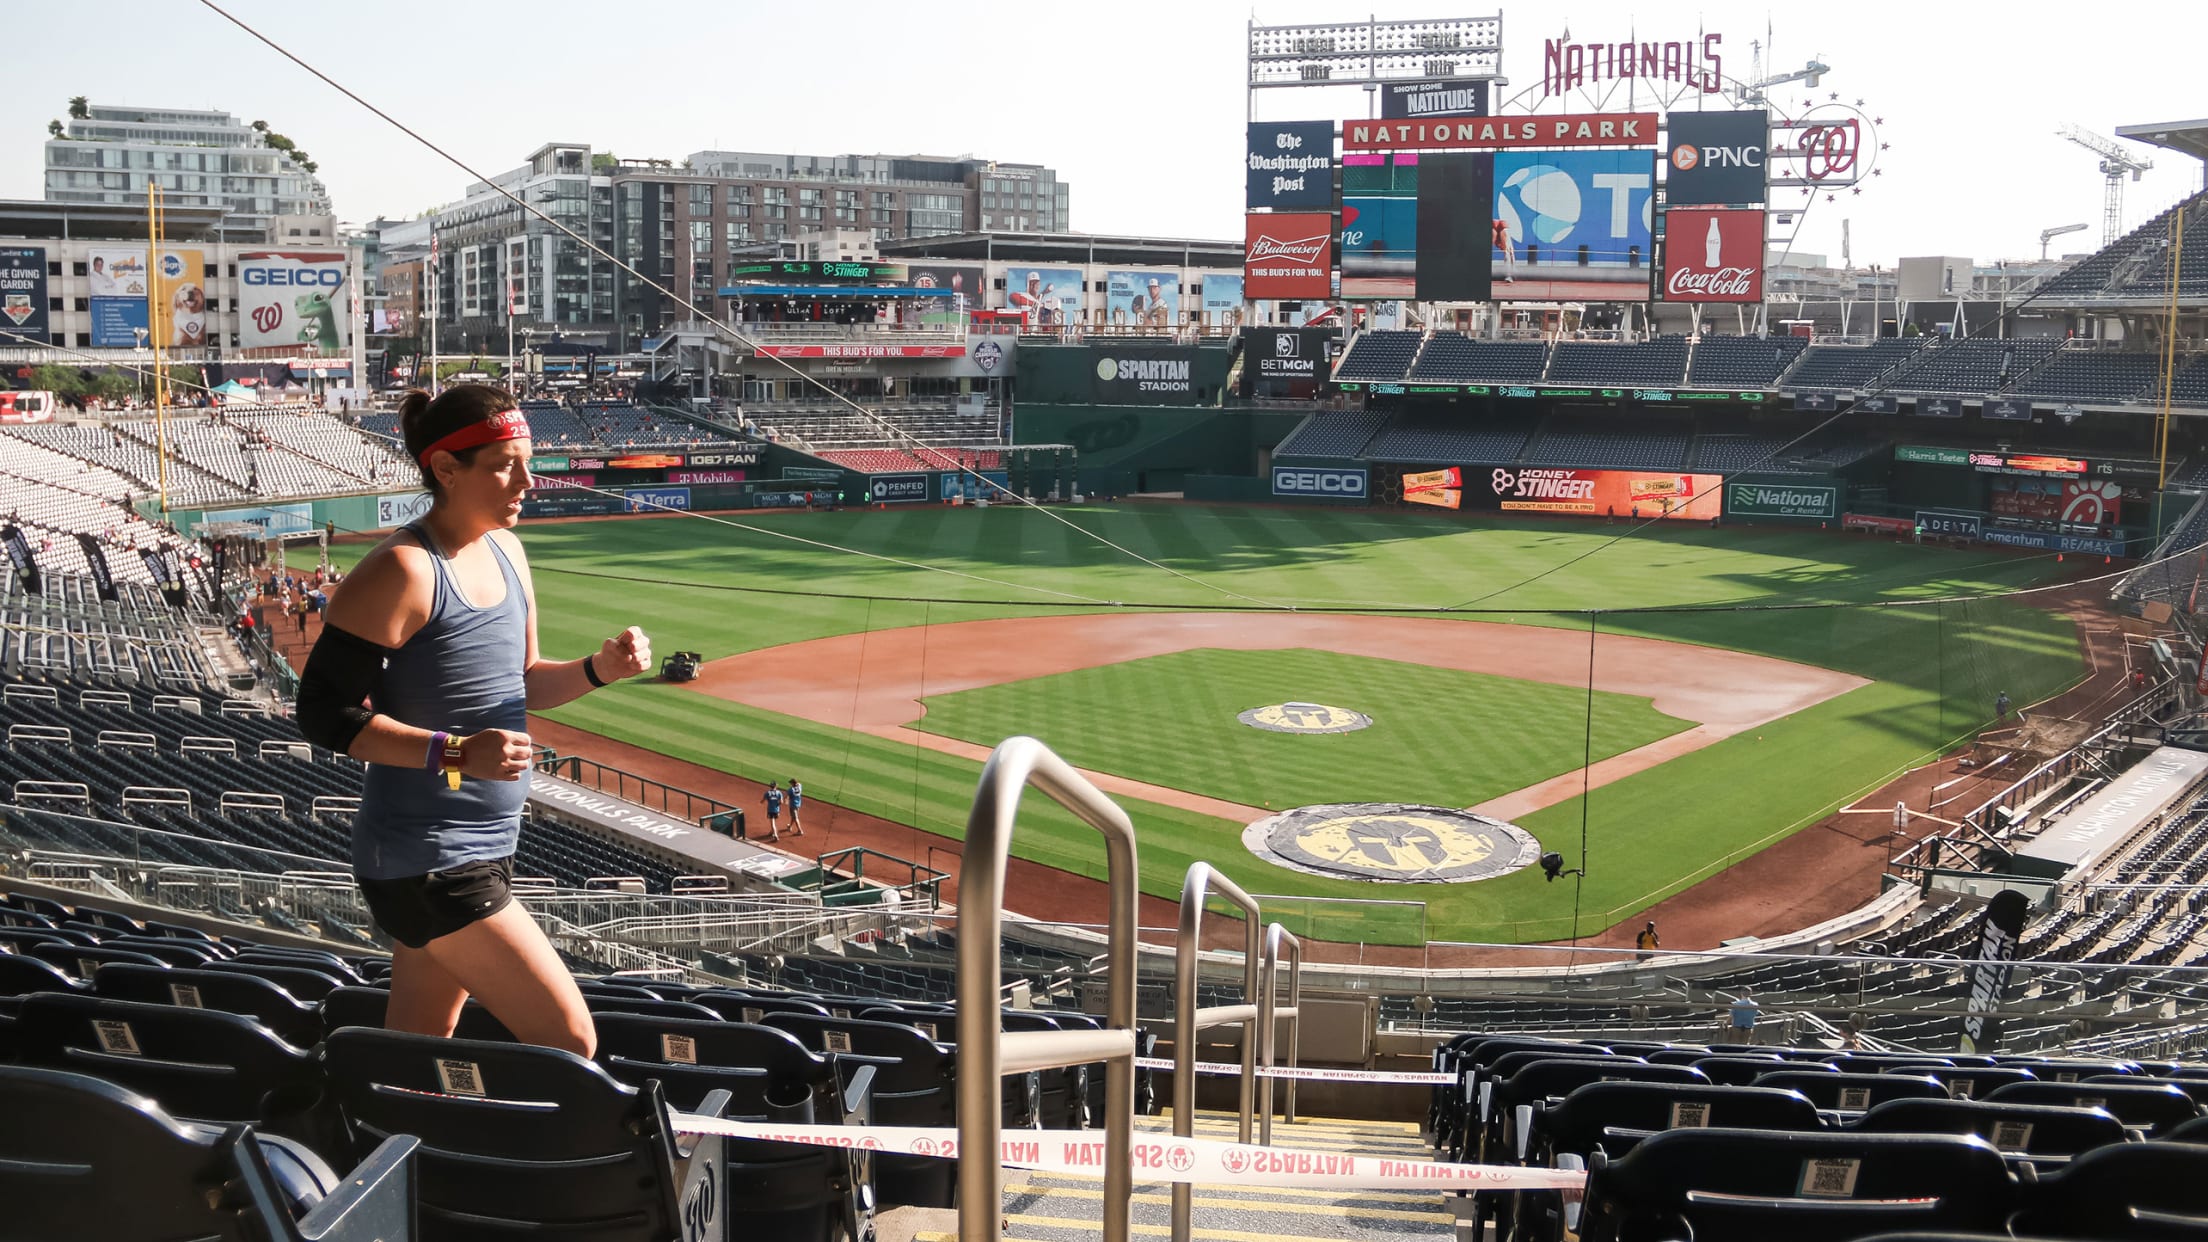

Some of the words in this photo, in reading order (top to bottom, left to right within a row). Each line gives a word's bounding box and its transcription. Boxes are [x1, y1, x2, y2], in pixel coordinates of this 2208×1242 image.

[1545, 33, 1721, 96] NATIONALS
[1393, 85, 1418, 94] SHOW
[1420, 83, 1443, 92] SOME
[1407, 88, 1475, 113] NATITUDE
[1354, 122, 1537, 143] NATIONALS
[1555, 120, 1641, 139] PARK
[1276, 133, 1302, 150] The
[1249, 152, 1330, 172] Washington
[1702, 146, 1761, 168] PNC
[1272, 176, 1305, 195] Post
[1252, 240, 1321, 255] Budweiser
[11, 268, 40, 279] GIVING
[243, 267, 342, 286] GEICO
[834, 267, 869, 278] STINGER
[1252, 268, 1268, 277] THIS
[1269, 268, 1290, 277] BUD'S
[1291, 268, 1306, 277] FOR
[1307, 268, 1324, 277] YOU.
[1, 280, 34, 290] GARDEN
[919, 279, 931, 288] 15
[1668, 266, 1756, 295] Coca-Cola
[822, 346, 842, 356] THIS
[842, 346, 867, 356] BUD'S
[868, 346, 885, 356] FOR
[886, 346, 904, 356] YOU.
[1118, 359, 1190, 380] SPARTAN
[1260, 359, 1314, 370] BETMGM
[1139, 381, 1190, 391] STADION
[725, 454, 756, 464] FAN
[1908, 451, 1936, 461] Harris
[1518, 469, 1576, 479] HONEY
[2097, 463, 2113, 474] rts
[692, 472, 734, 484] Mobile
[1276, 472, 1363, 492] GEICO
[888, 481, 924, 490] PENFED
[1513, 478, 1595, 499] STINGER
[645, 493, 685, 506] Terra
[1756, 489, 1828, 507] National
[1780, 506, 1794, 514] Car
[1797, 507, 1825, 515] Rental
[620, 813, 690, 839] PARK
[1964, 918, 2006, 1041] SPARTAN
